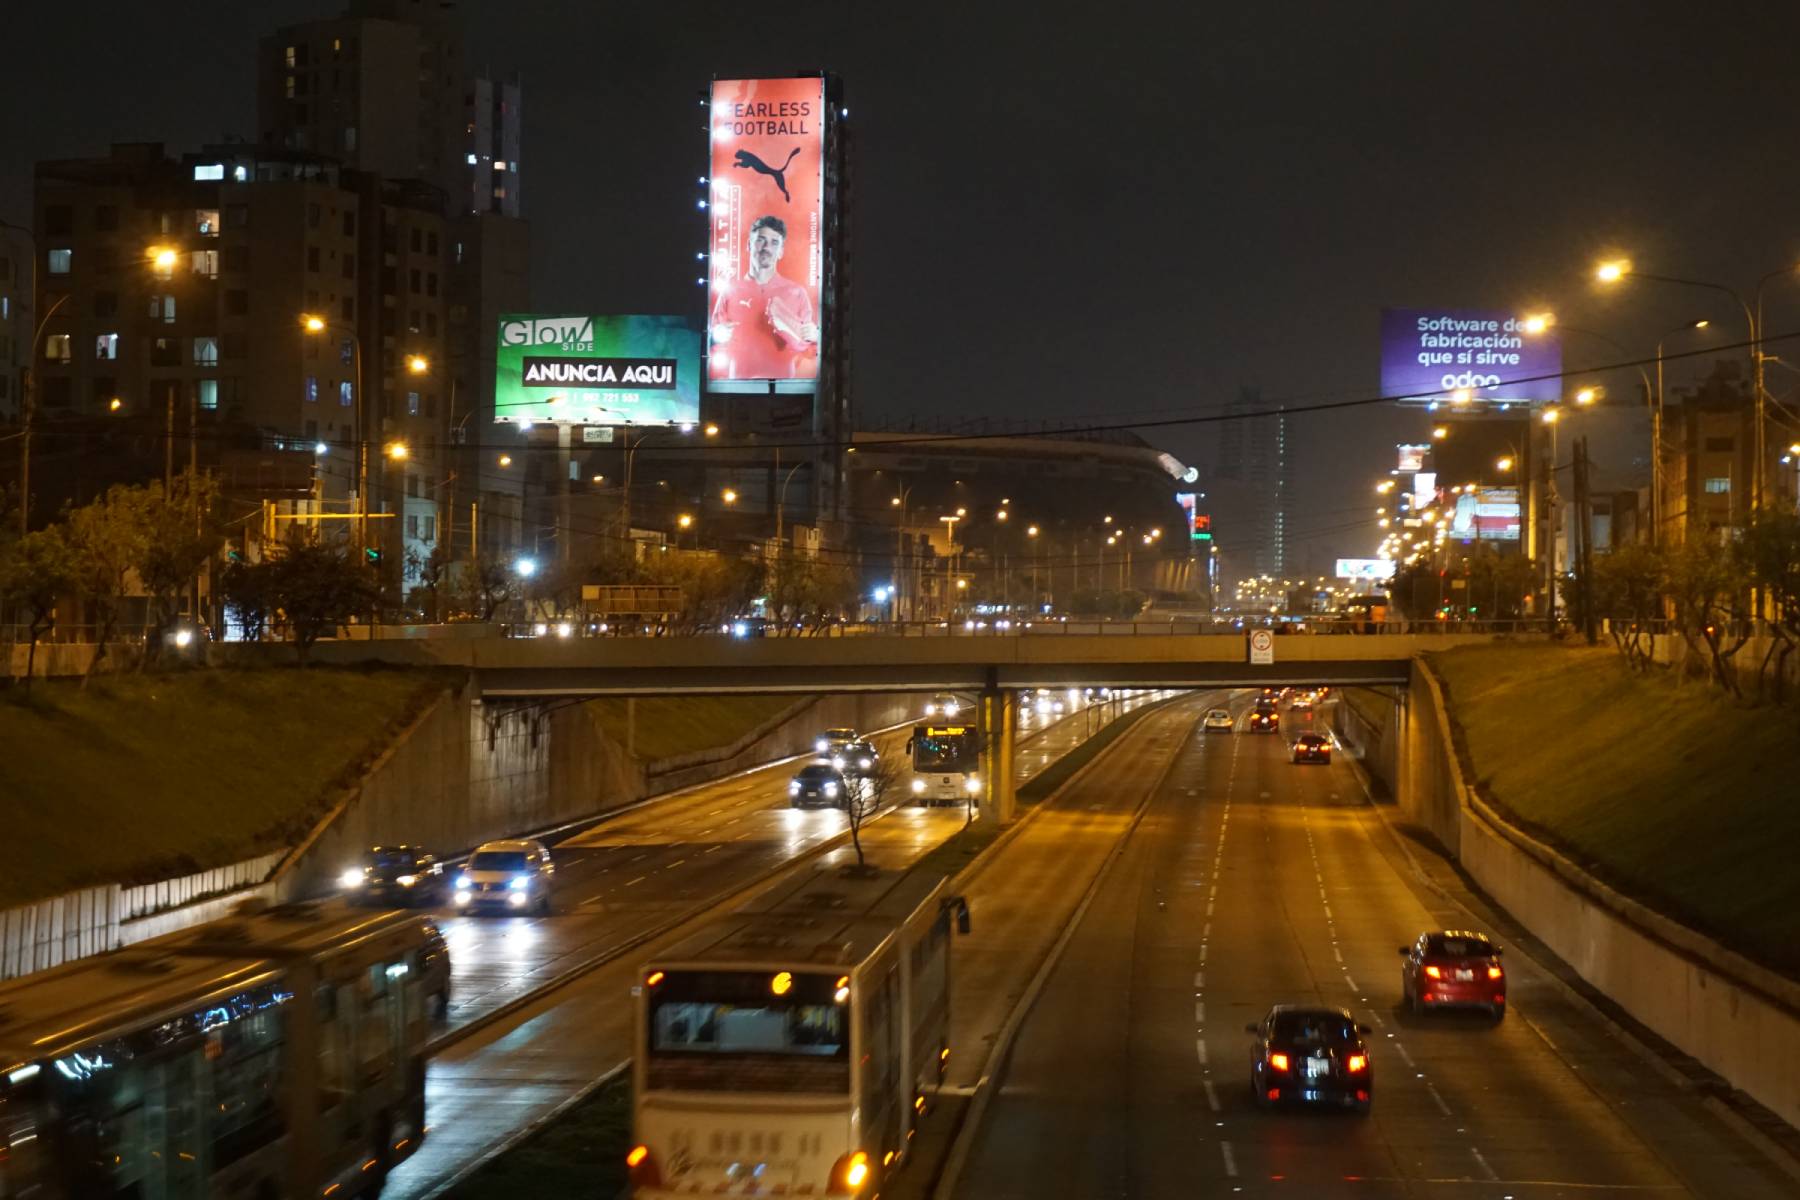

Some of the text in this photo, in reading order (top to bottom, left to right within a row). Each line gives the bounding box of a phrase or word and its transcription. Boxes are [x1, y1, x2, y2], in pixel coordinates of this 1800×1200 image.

[1417, 316, 1526, 332] Software de
[562, 342, 594, 352] SIDE
[1421, 333, 1522, 348] fabricación
[1417, 349, 1520, 367] que sí sirve
[525, 363, 673, 383] ANUNCIA AQUI
[1441, 370, 1501, 391] odoo
